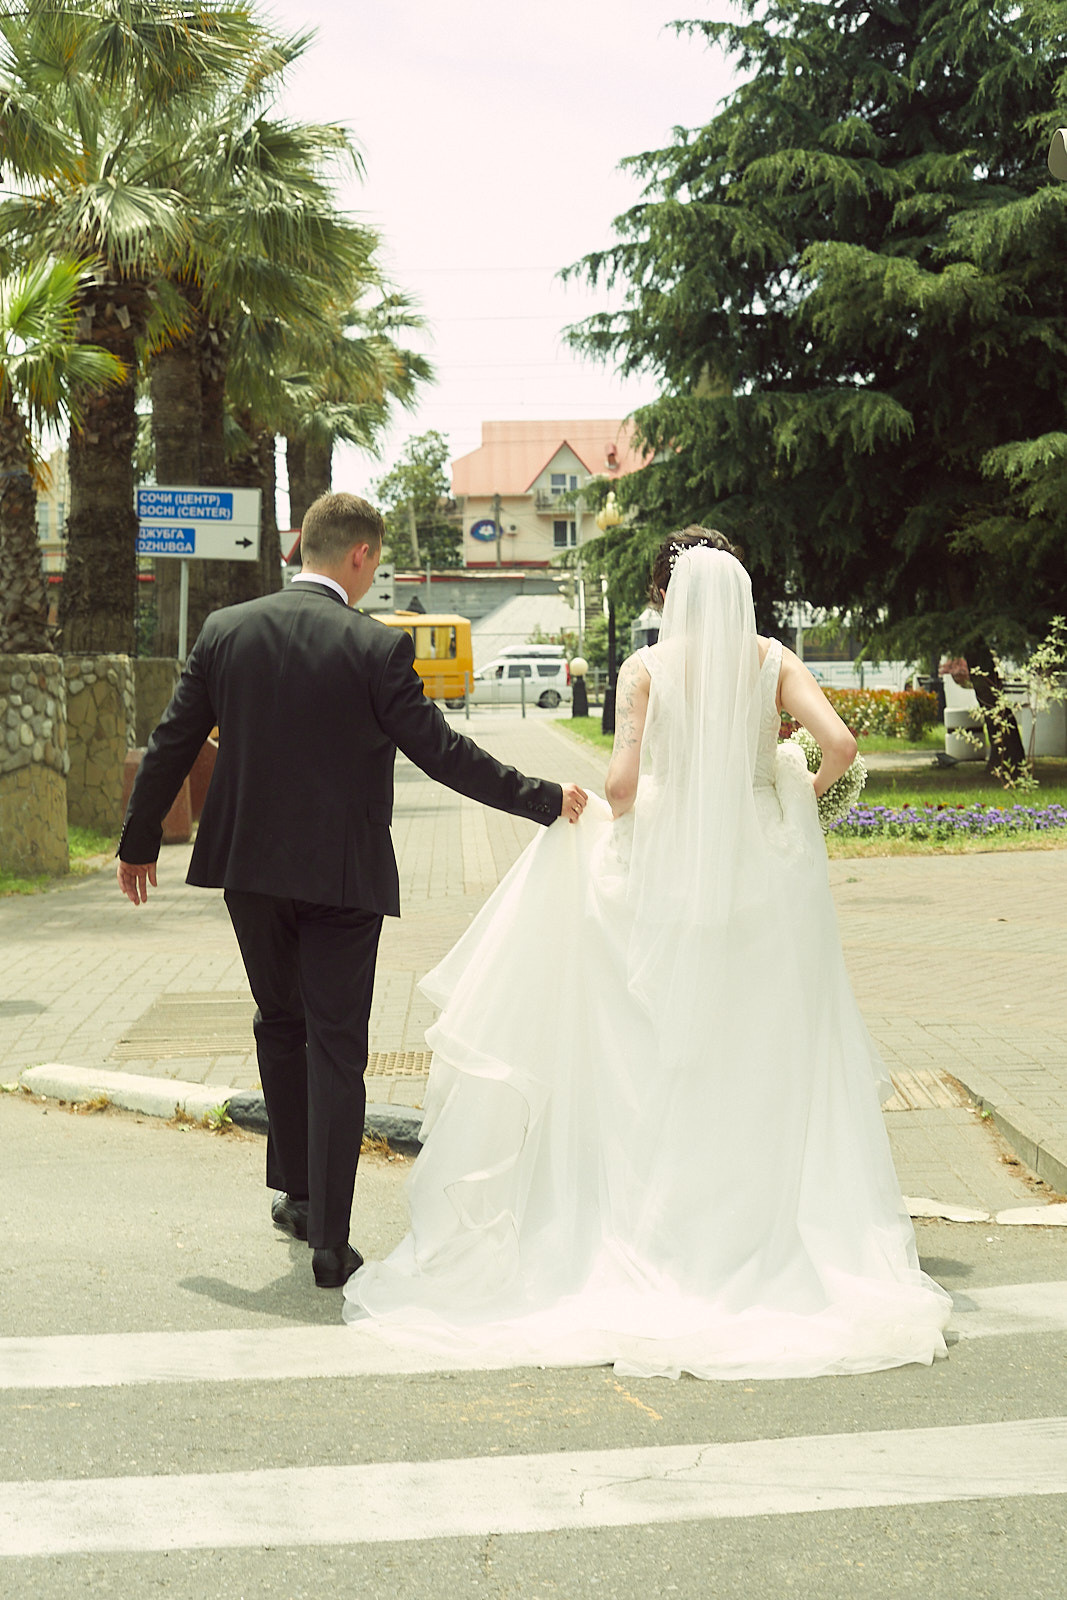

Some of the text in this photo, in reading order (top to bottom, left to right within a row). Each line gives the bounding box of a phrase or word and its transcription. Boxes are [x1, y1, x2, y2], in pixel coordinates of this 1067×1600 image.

[139, 492, 220, 506] СОЧИ (ЦЕНТР)
[139, 505, 231, 519] SOCHI (CENTER)
[138, 528, 185, 539] ДЖУБГА
[138, 540, 193, 552] DZHUBGA
